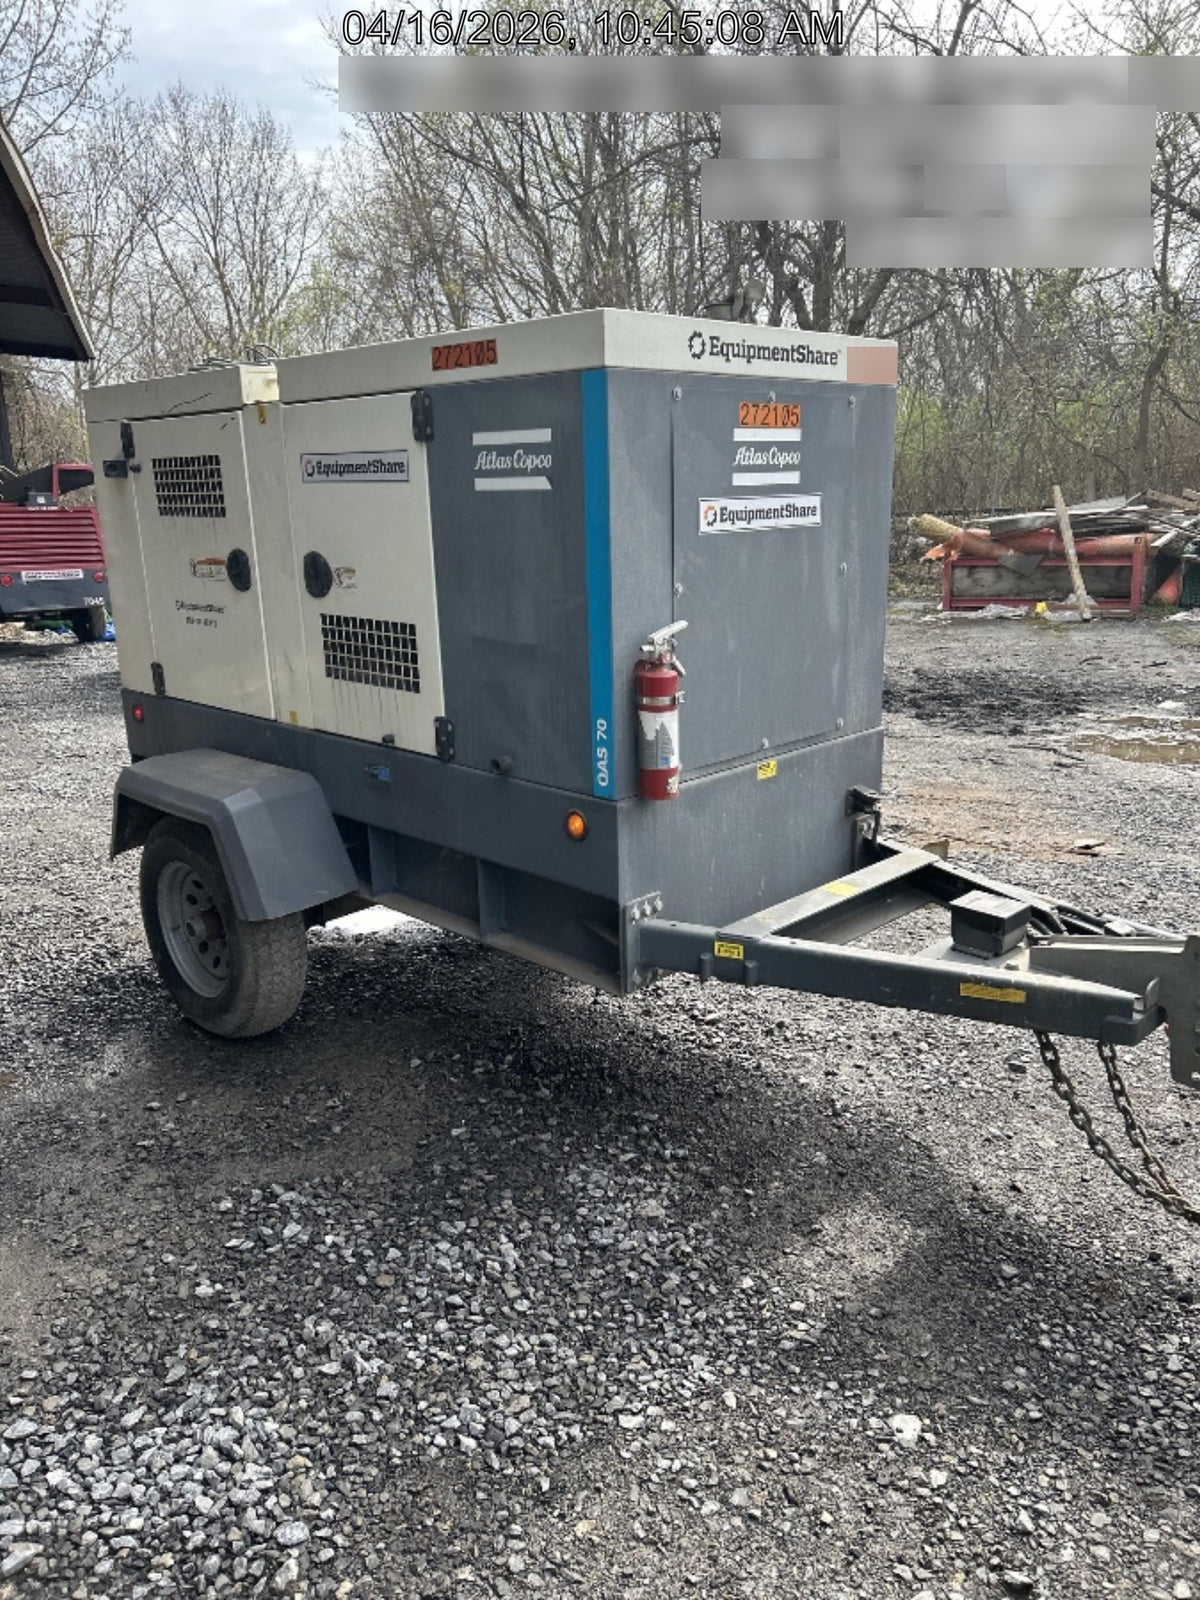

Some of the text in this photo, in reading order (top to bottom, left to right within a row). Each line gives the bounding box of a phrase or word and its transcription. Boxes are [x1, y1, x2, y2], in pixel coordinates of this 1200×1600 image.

[432, 339, 497, 370] 272105
[709, 335, 838, 365] EquipmentShare
[740, 403, 800, 427] 272105
[316, 459, 406, 477] EquipmentShare
[474, 449, 552, 473] Atlas Copco
[733, 446, 800, 468] Atlas Copco
[719, 503, 817, 525] EquipmentShare
[597, 718, 607, 740] 70
